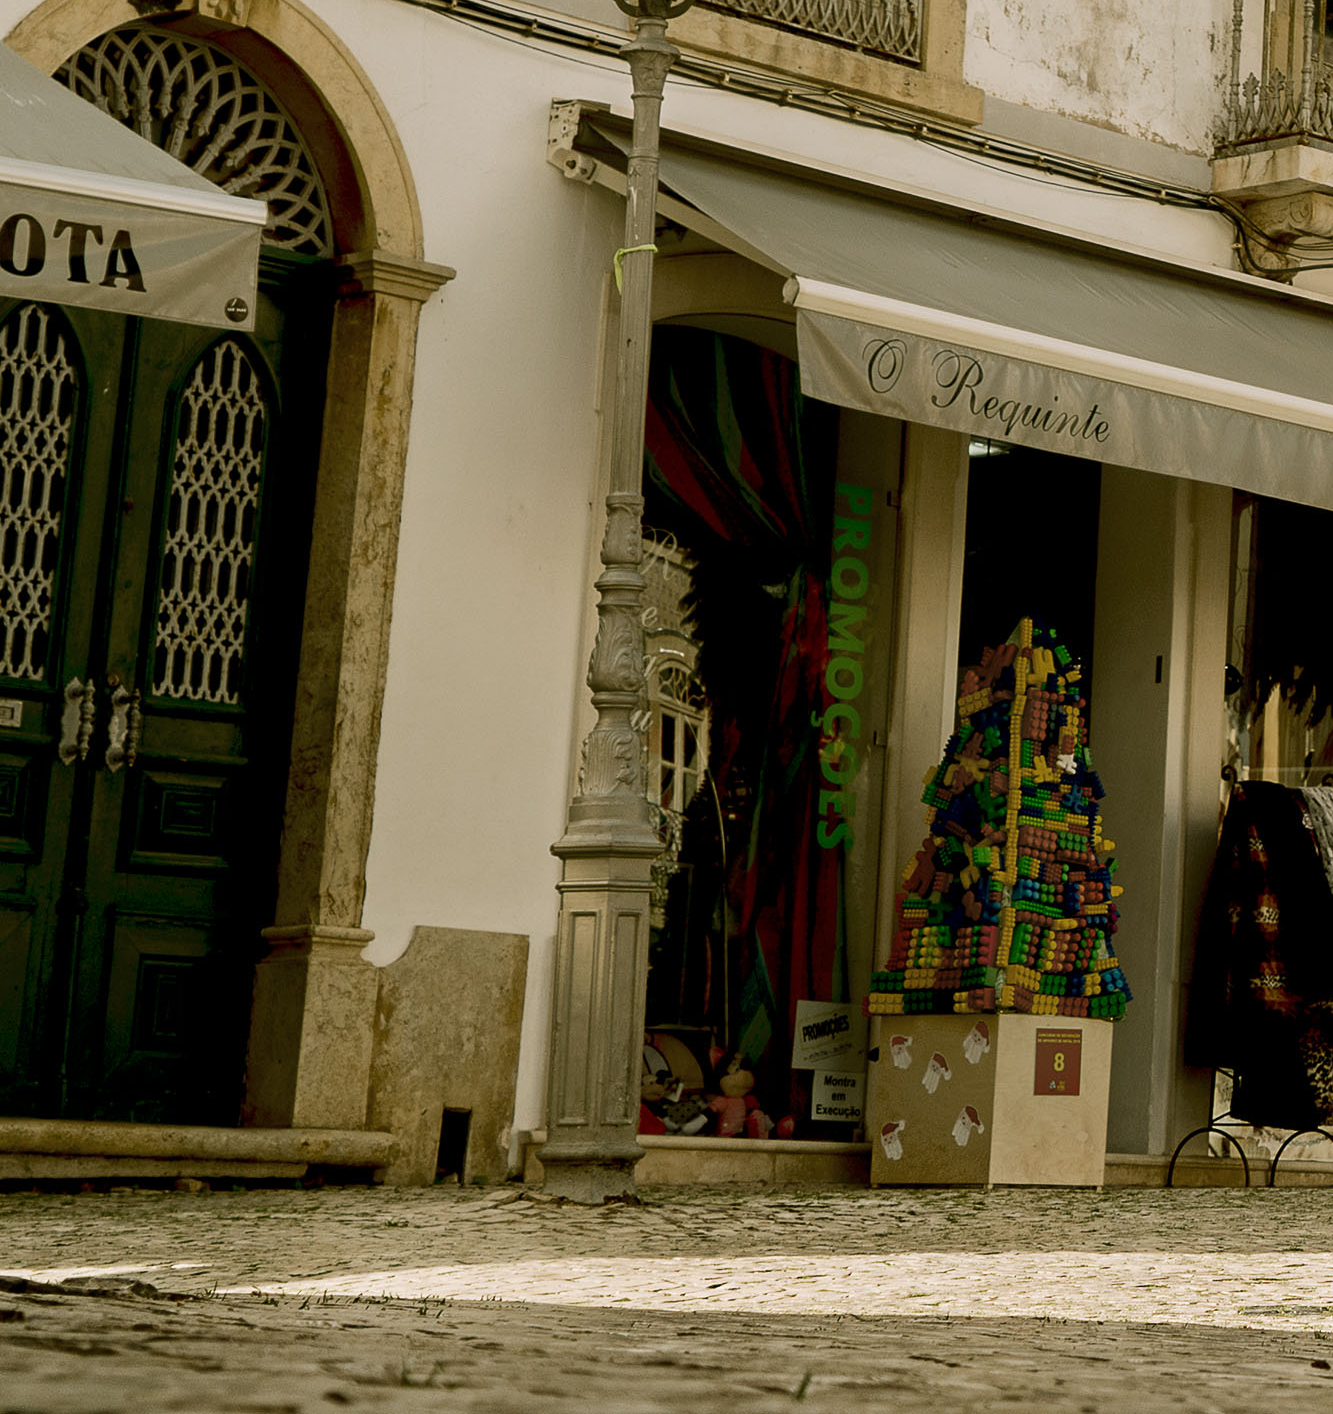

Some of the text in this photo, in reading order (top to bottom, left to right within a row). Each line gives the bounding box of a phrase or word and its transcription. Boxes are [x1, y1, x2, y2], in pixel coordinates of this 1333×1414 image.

[862, 339, 1110, 443] O Requinte
[1053, 1052, 1066, 1072] 8
[823, 1075, 857, 1088] Montra
[831, 1092, 847, 1102] em
[815, 1103, 861, 1119] Execução
